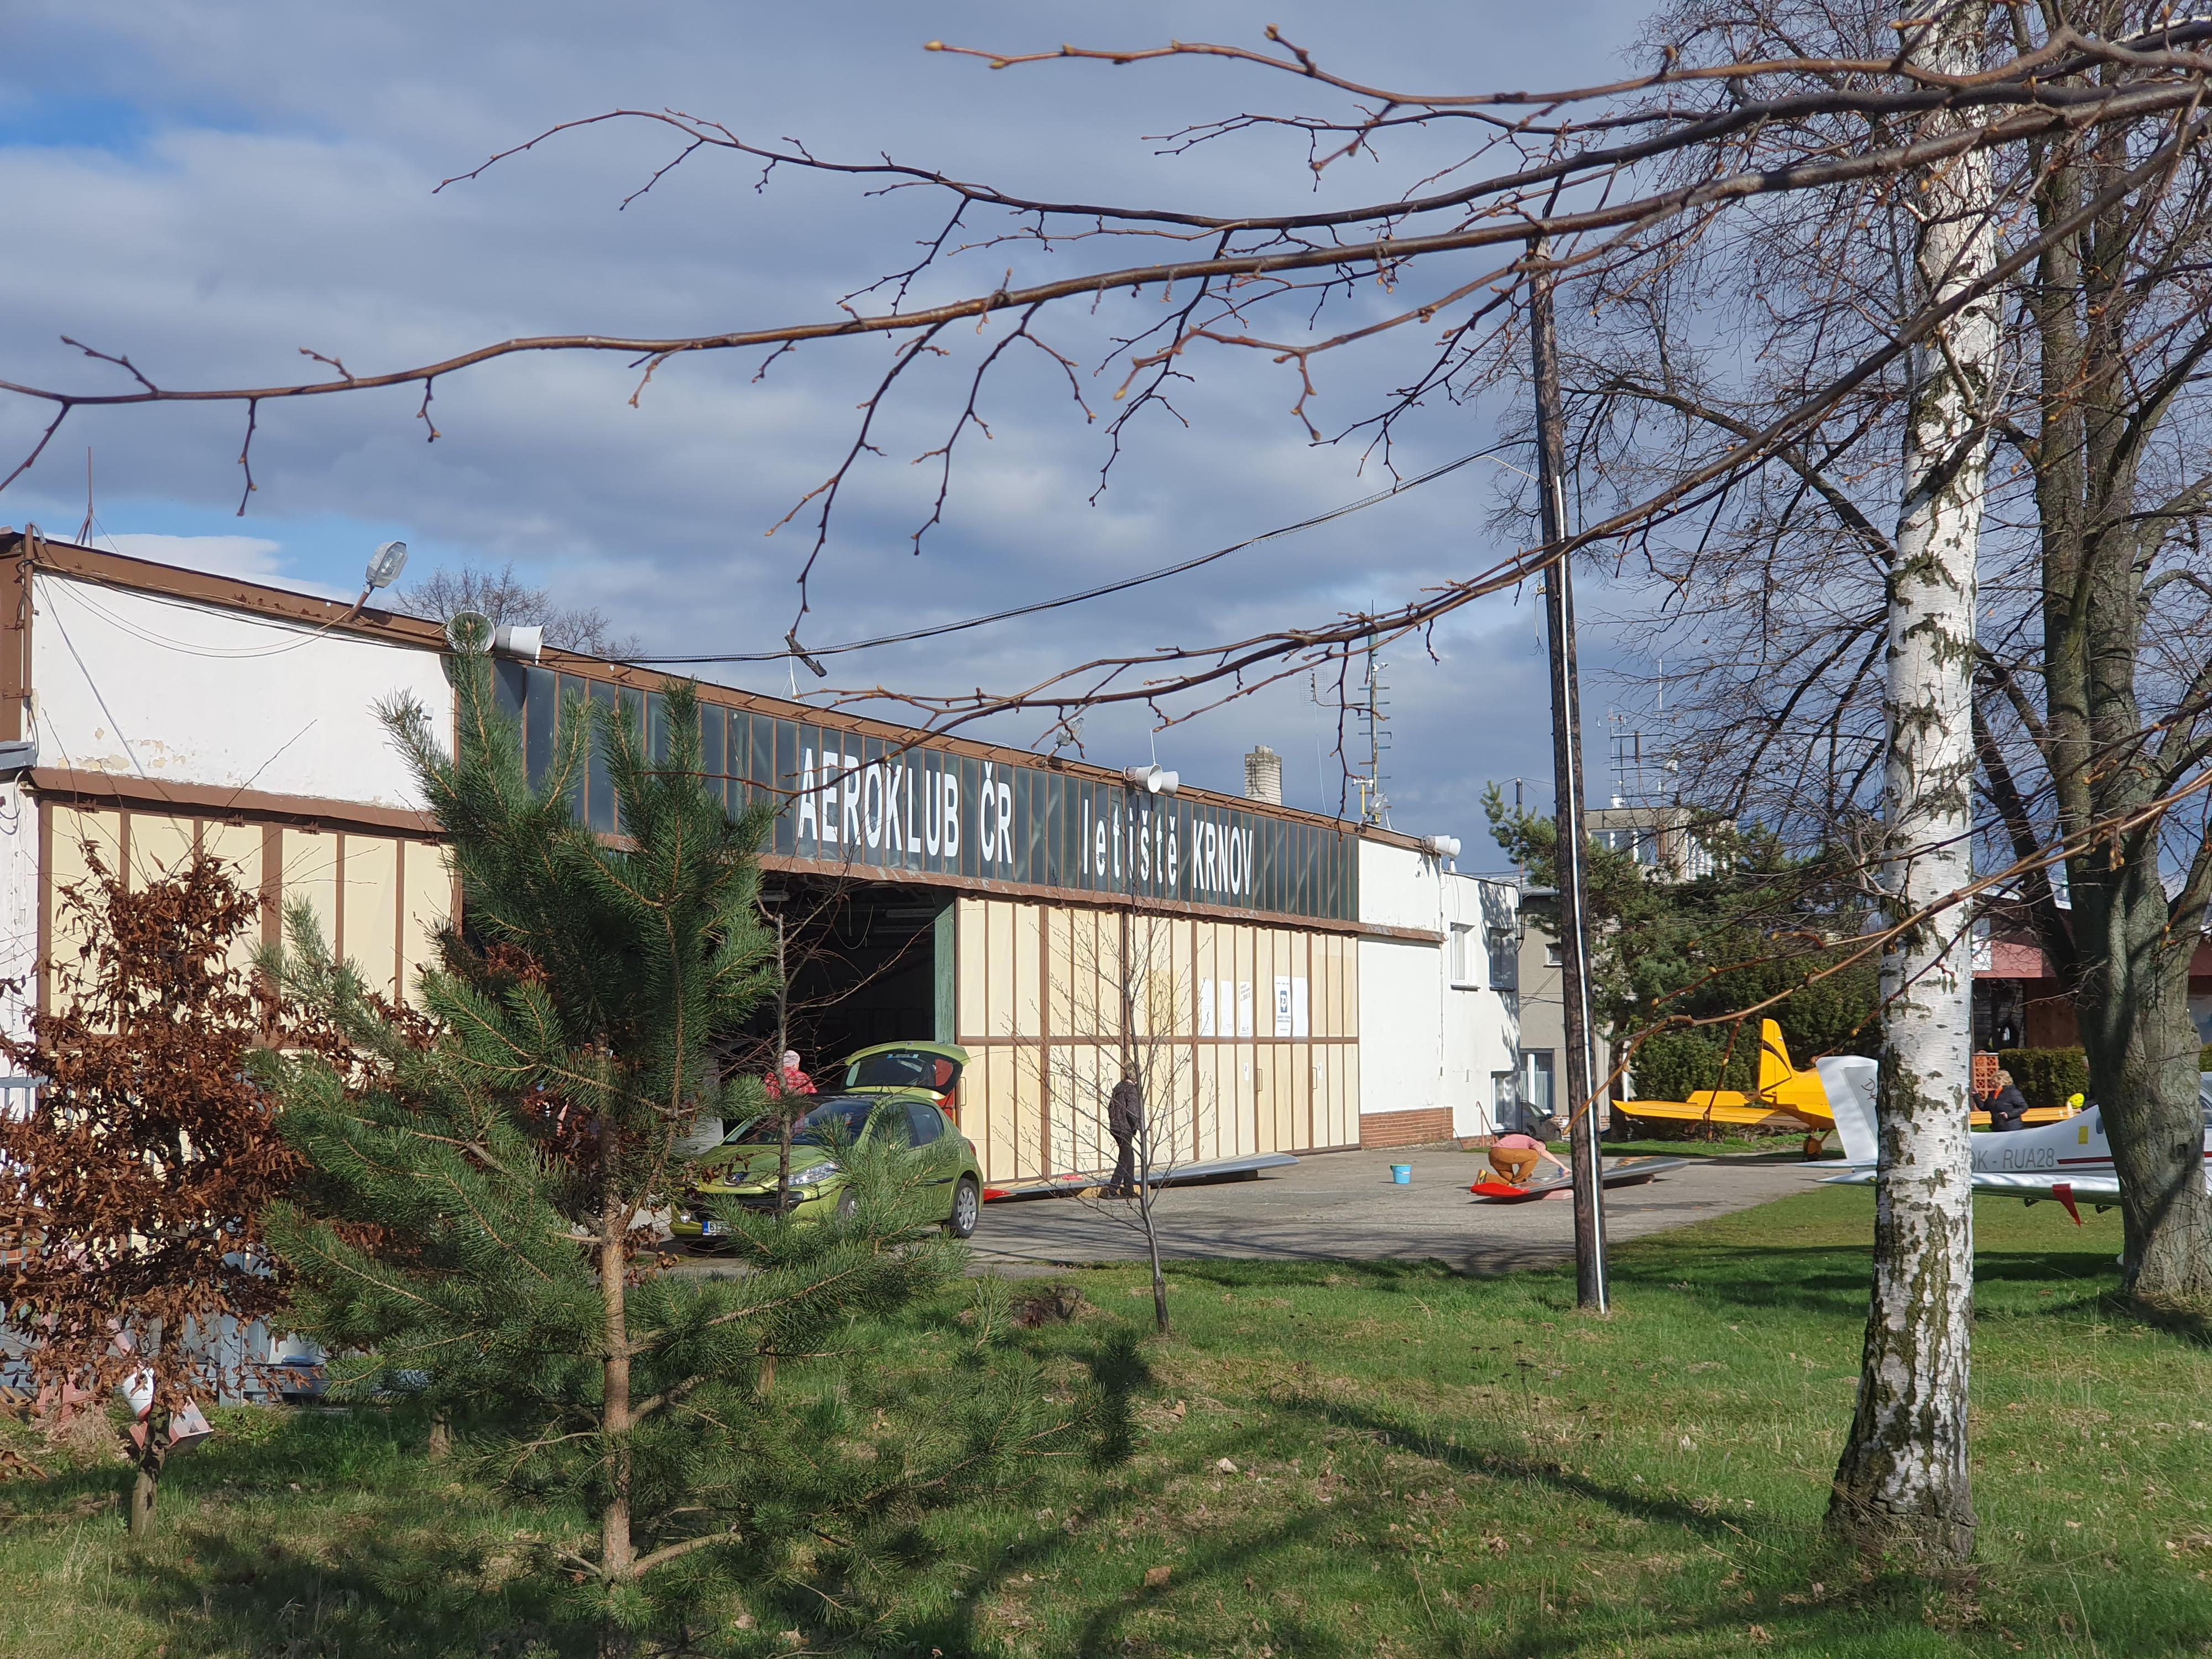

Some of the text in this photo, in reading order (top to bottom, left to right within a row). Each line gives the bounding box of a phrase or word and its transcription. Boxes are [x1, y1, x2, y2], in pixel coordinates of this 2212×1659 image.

[797, 748, 1253, 895] AEROKLUB ČR letiště KRNOV
[2002, 1147, 2055, 1169] RUA28
